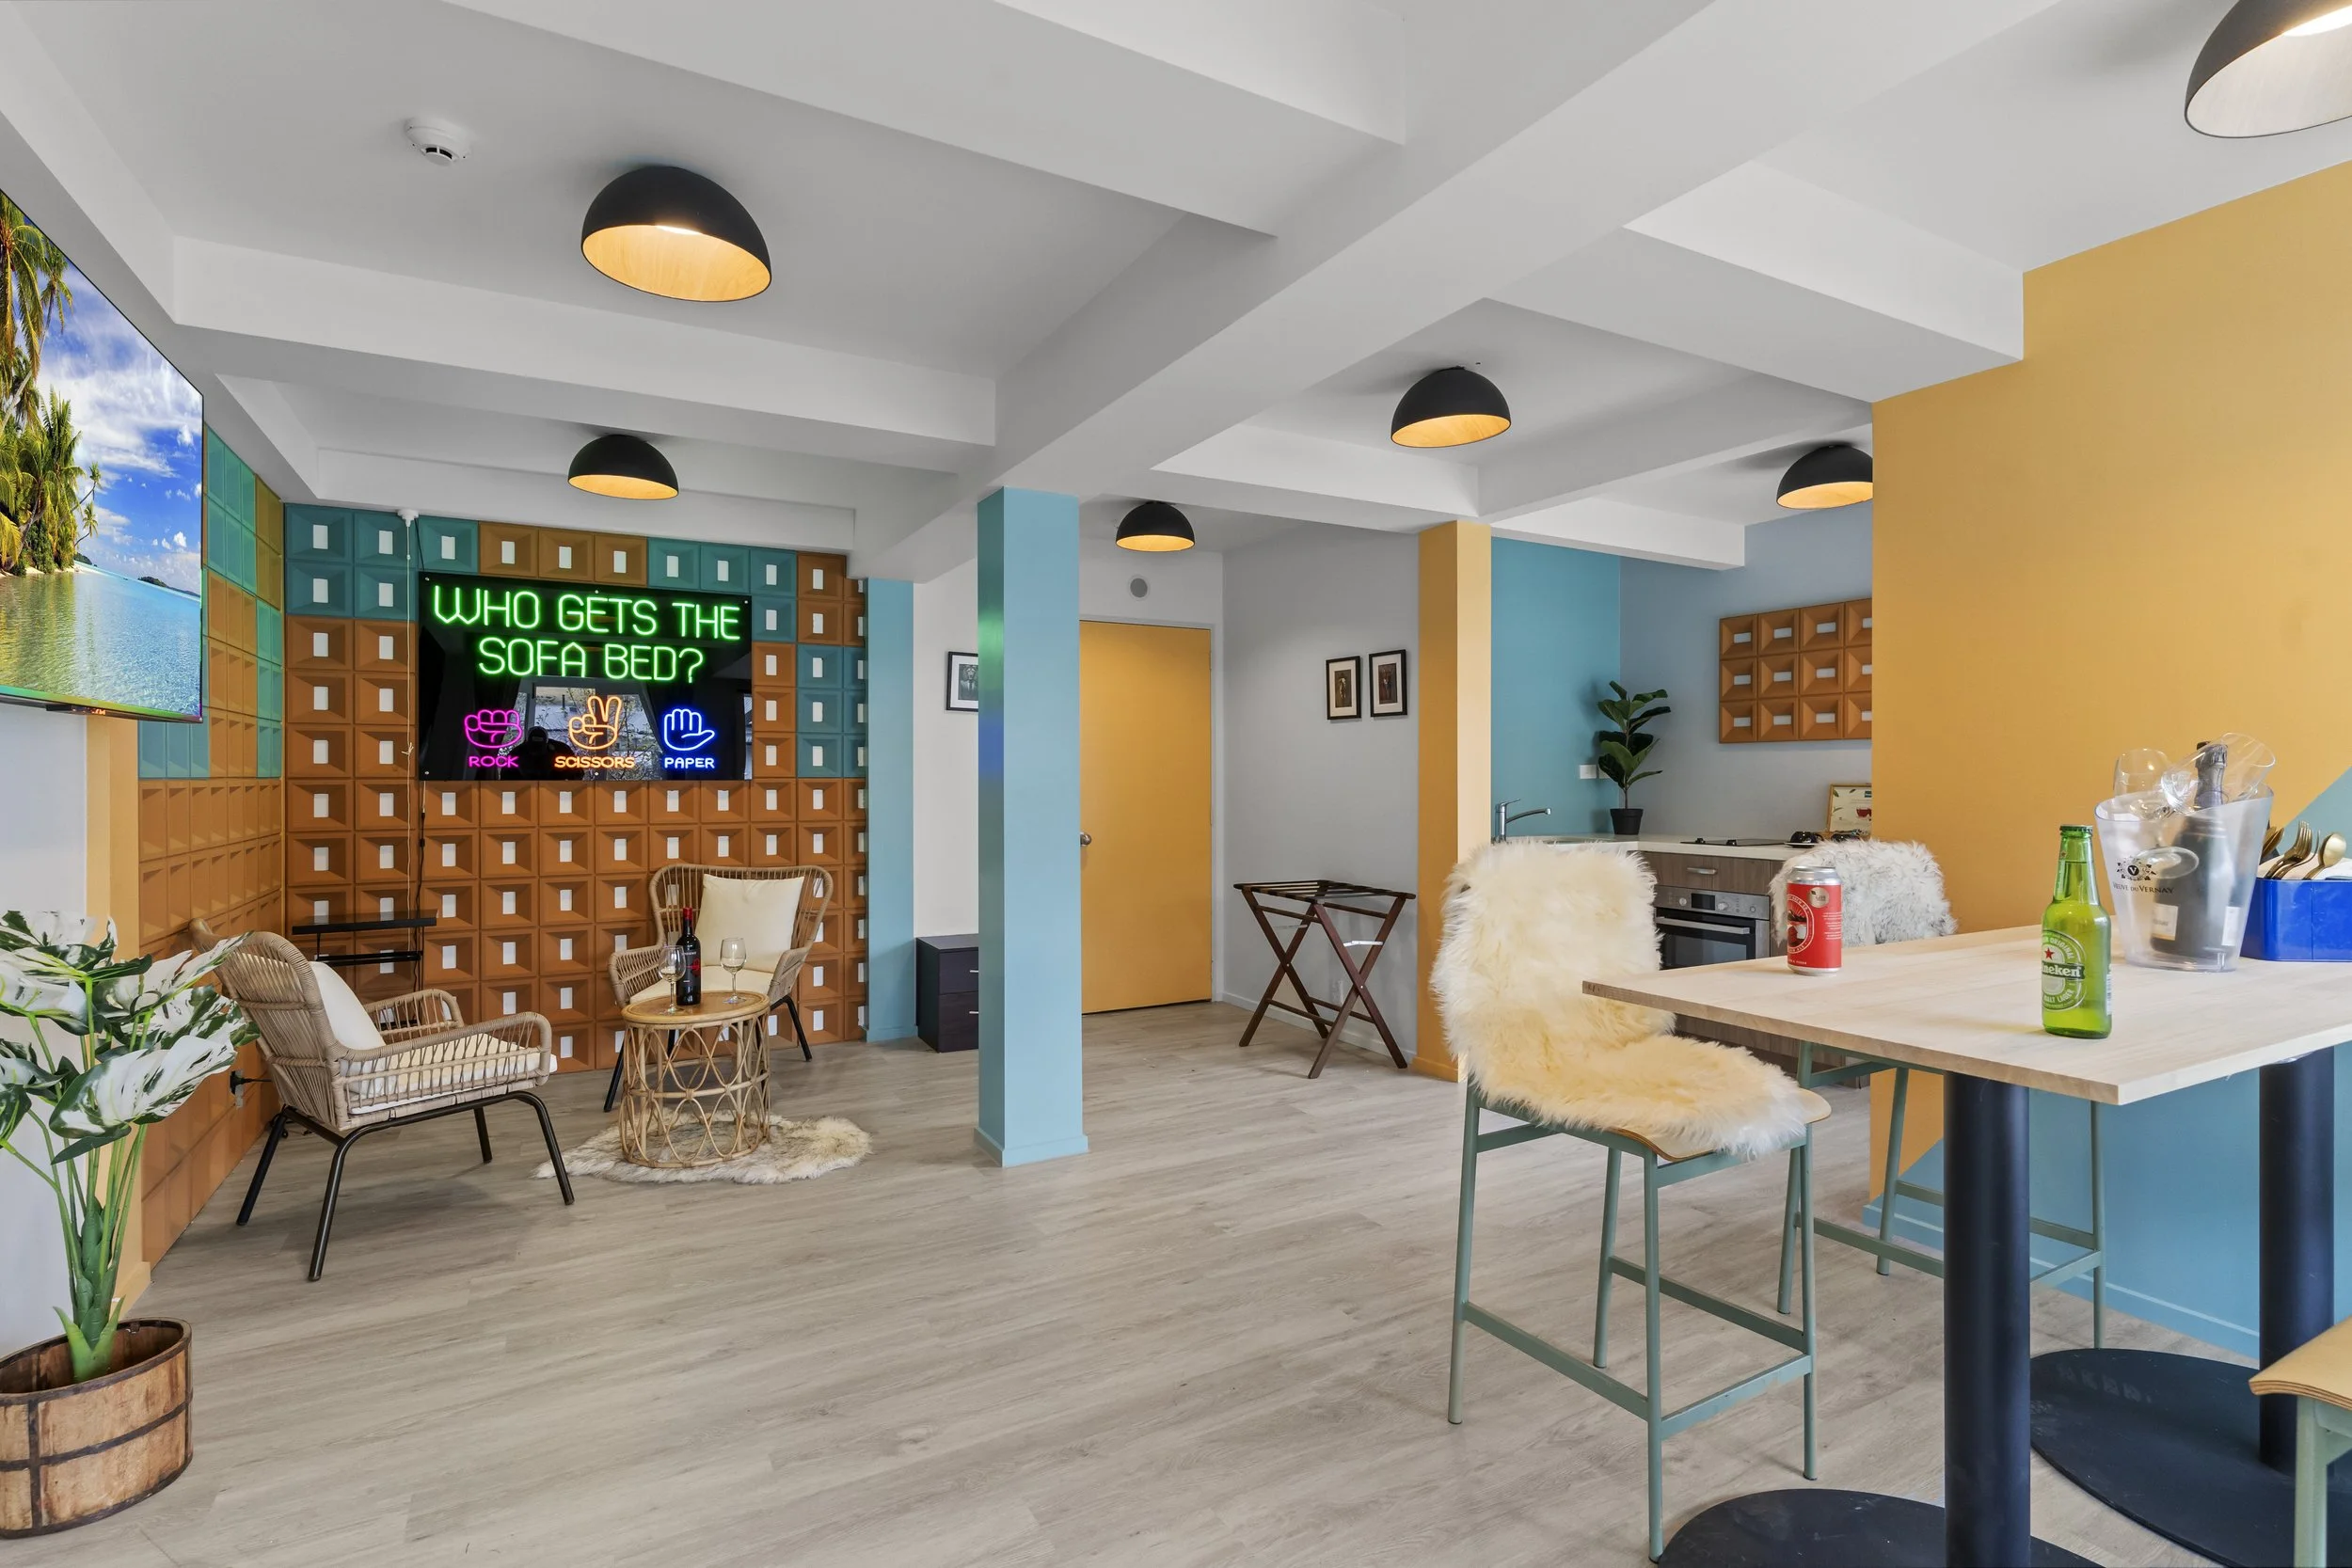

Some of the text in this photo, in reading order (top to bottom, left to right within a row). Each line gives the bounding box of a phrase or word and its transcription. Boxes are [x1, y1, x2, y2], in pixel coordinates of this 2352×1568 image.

[434, 584, 740, 640] WHO GETS THE
[478, 636, 704, 684] SOFA BED?
[469, 754, 519, 768] ROCK
[554, 754, 636, 769] SCISSORS
[663, 755, 715, 769] PAPER
[2138, 885, 2175, 894] VERNAY
